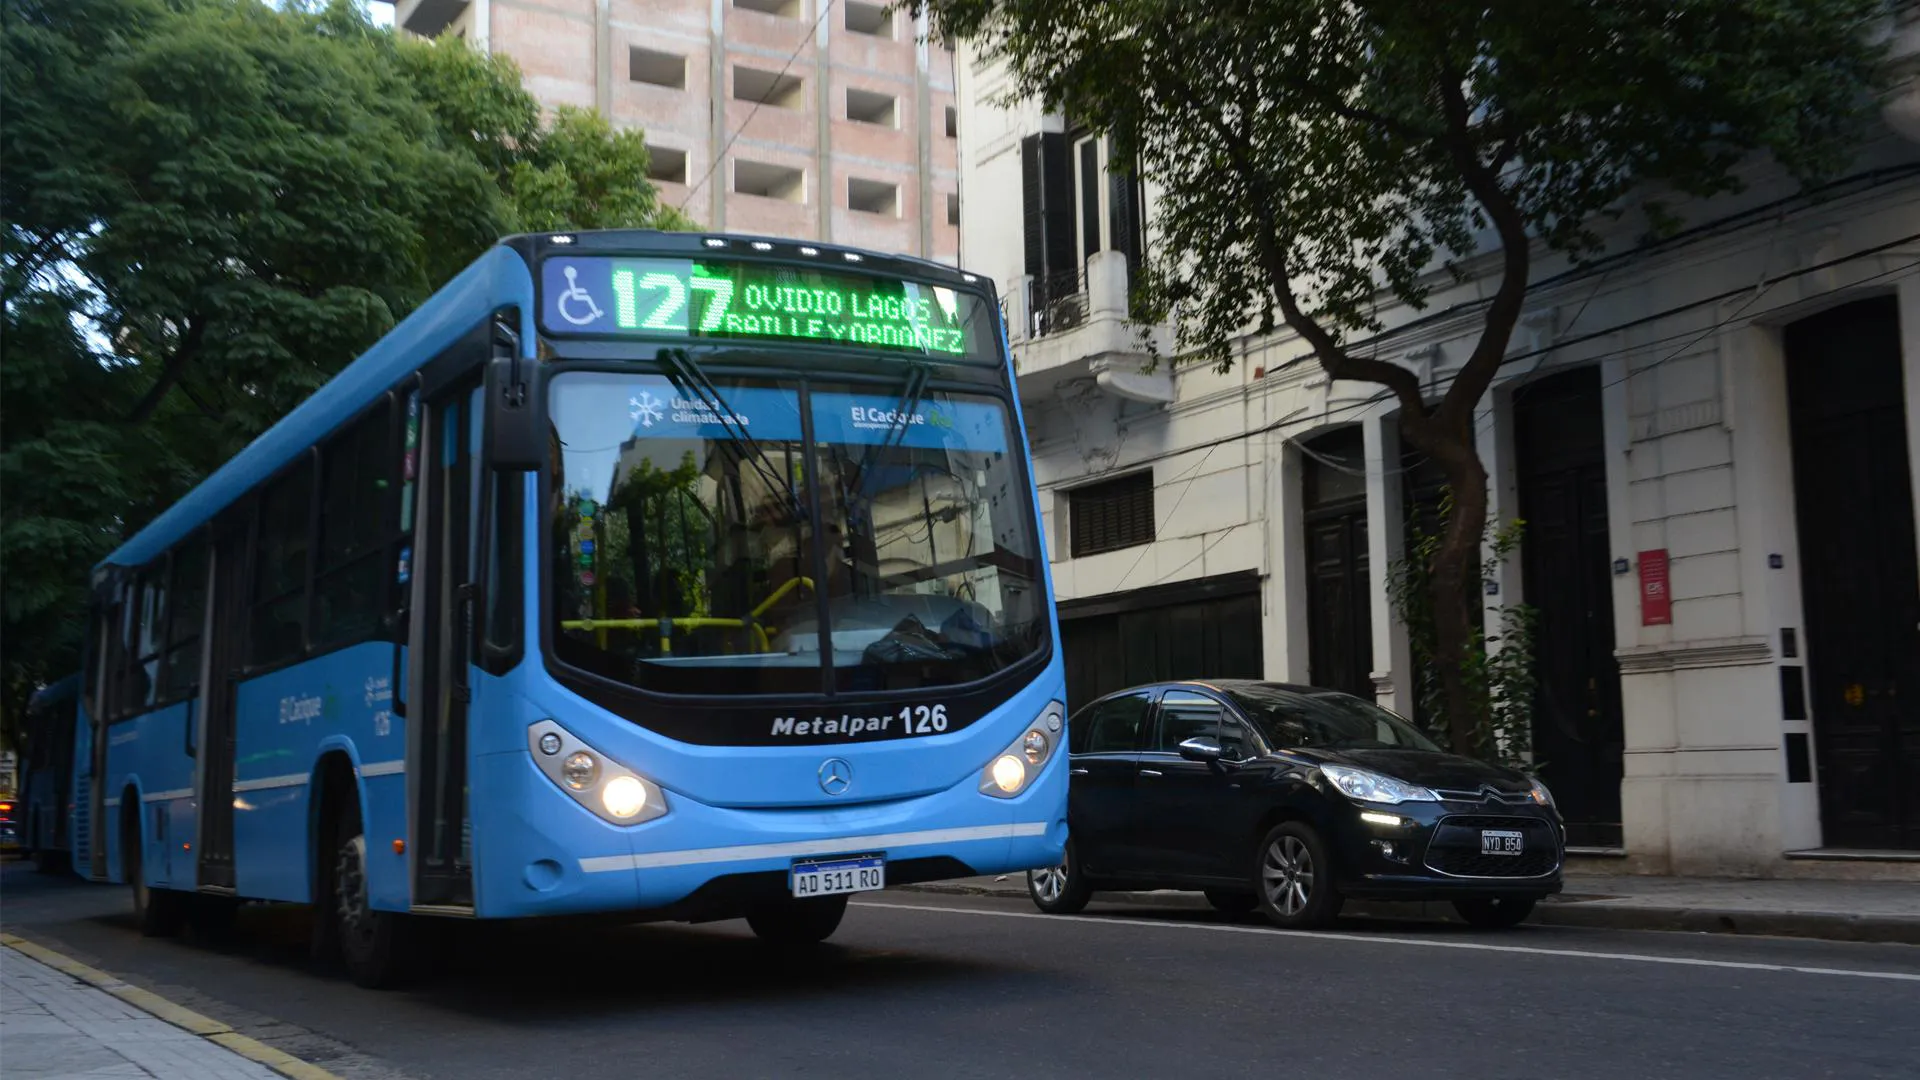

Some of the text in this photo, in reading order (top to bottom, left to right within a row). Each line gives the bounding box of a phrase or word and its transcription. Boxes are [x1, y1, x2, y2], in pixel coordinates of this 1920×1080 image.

[612, 270, 734, 332] 127
[745, 284, 931, 322] OVIDIO LAGOS
[851, 406, 865, 421] El
[771, 714, 893, 737] Metalpar
[899, 703, 948, 735] 126
[1484, 836, 1501, 851] NYD
[799, 874, 819, 894] AD
[824, 871, 854, 891] 511
